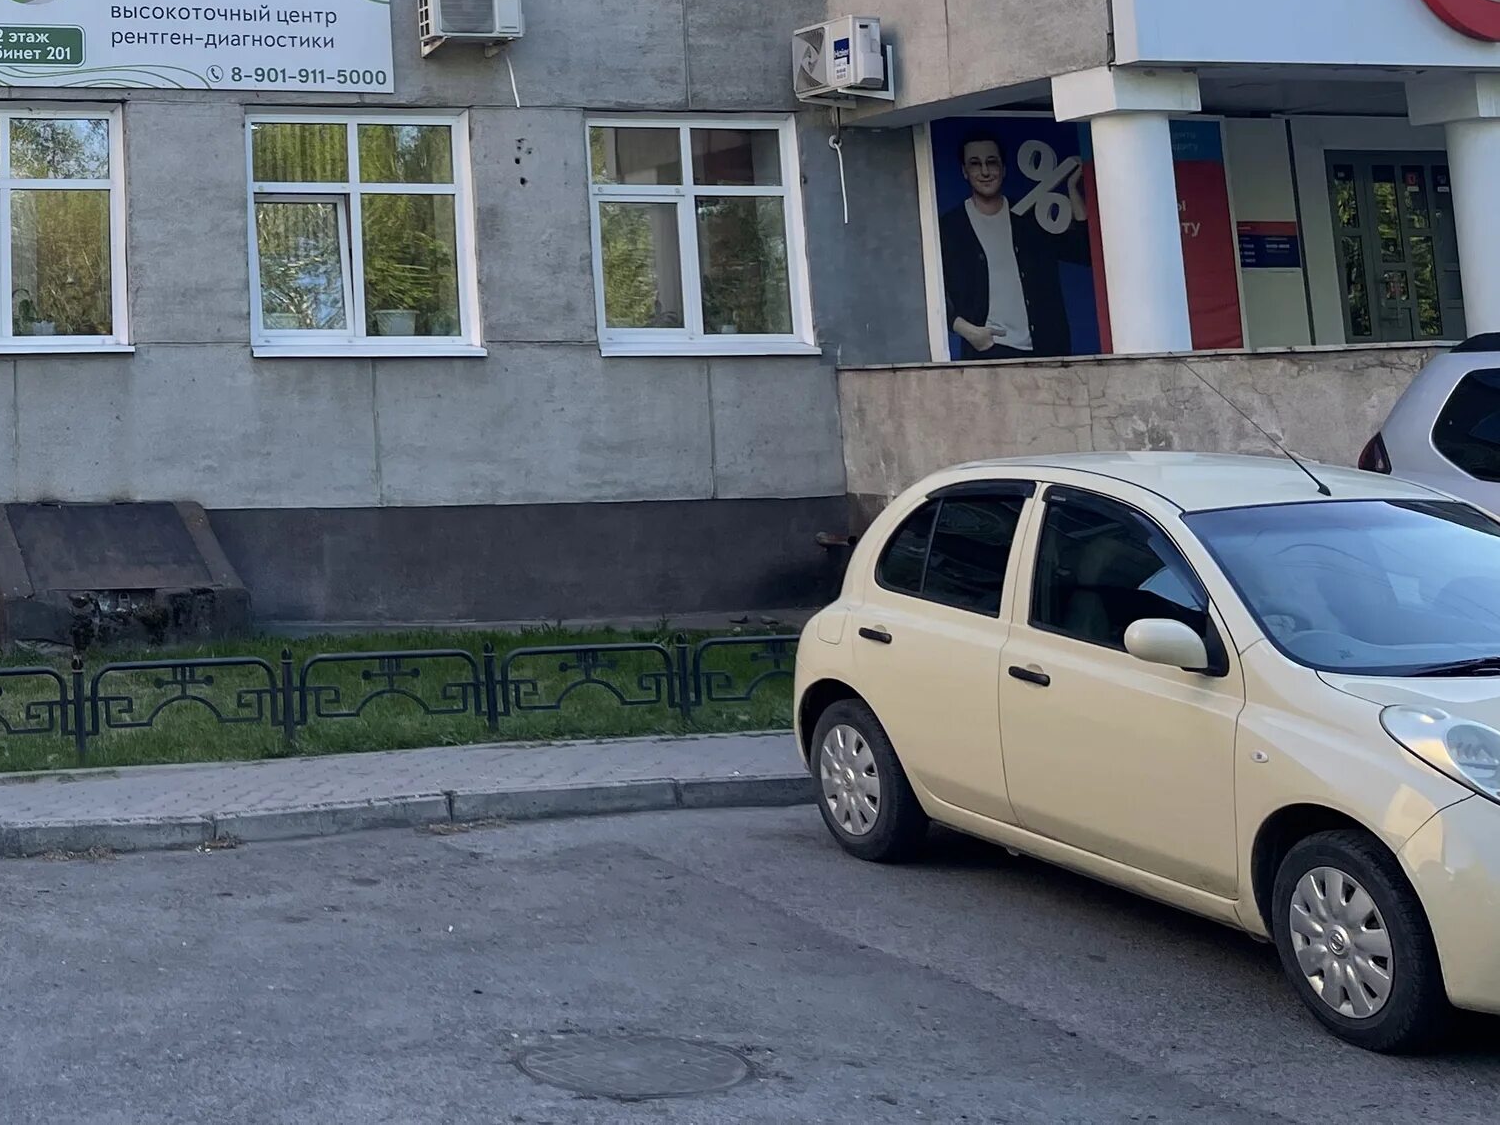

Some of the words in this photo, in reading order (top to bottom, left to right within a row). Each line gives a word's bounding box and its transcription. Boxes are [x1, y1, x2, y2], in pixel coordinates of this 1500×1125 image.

[110, 3, 271, 23] высокоточный
[276, 8, 338, 27] центр
[8, 32, 50, 44] этаж
[110, 29, 336, 49] рентген-диагностики
[46, 46, 71, 60] 201
[230, 67, 387, 85] 8-901-911-5000
